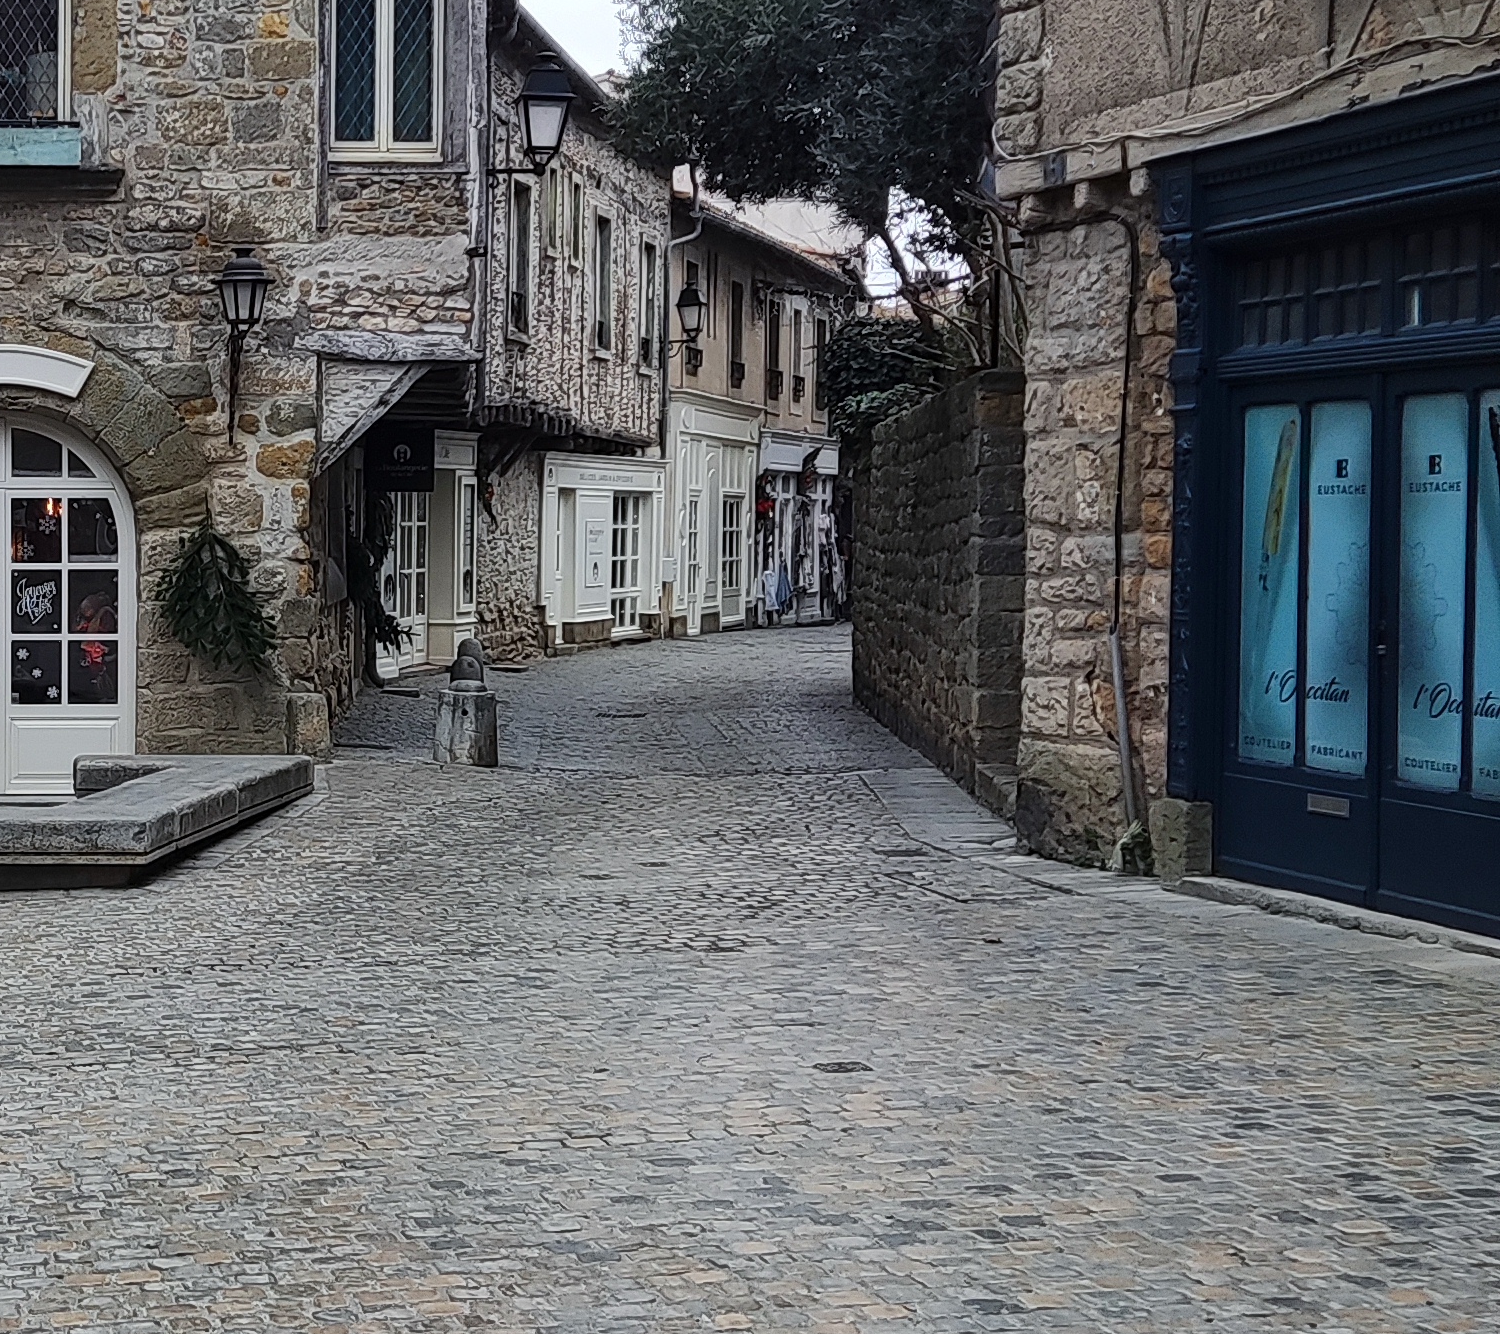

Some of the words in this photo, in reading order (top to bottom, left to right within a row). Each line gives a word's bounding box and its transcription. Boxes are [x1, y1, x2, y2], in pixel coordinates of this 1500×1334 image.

[1317, 484, 1367, 496] EUSTACHE
[1409, 481, 1462, 493] EUSTACHE
[1243, 735, 1292, 750] COUTELIER
[1311, 745, 1364, 760] FABRICANT
[1404, 756, 1459, 774] COUTELIER
